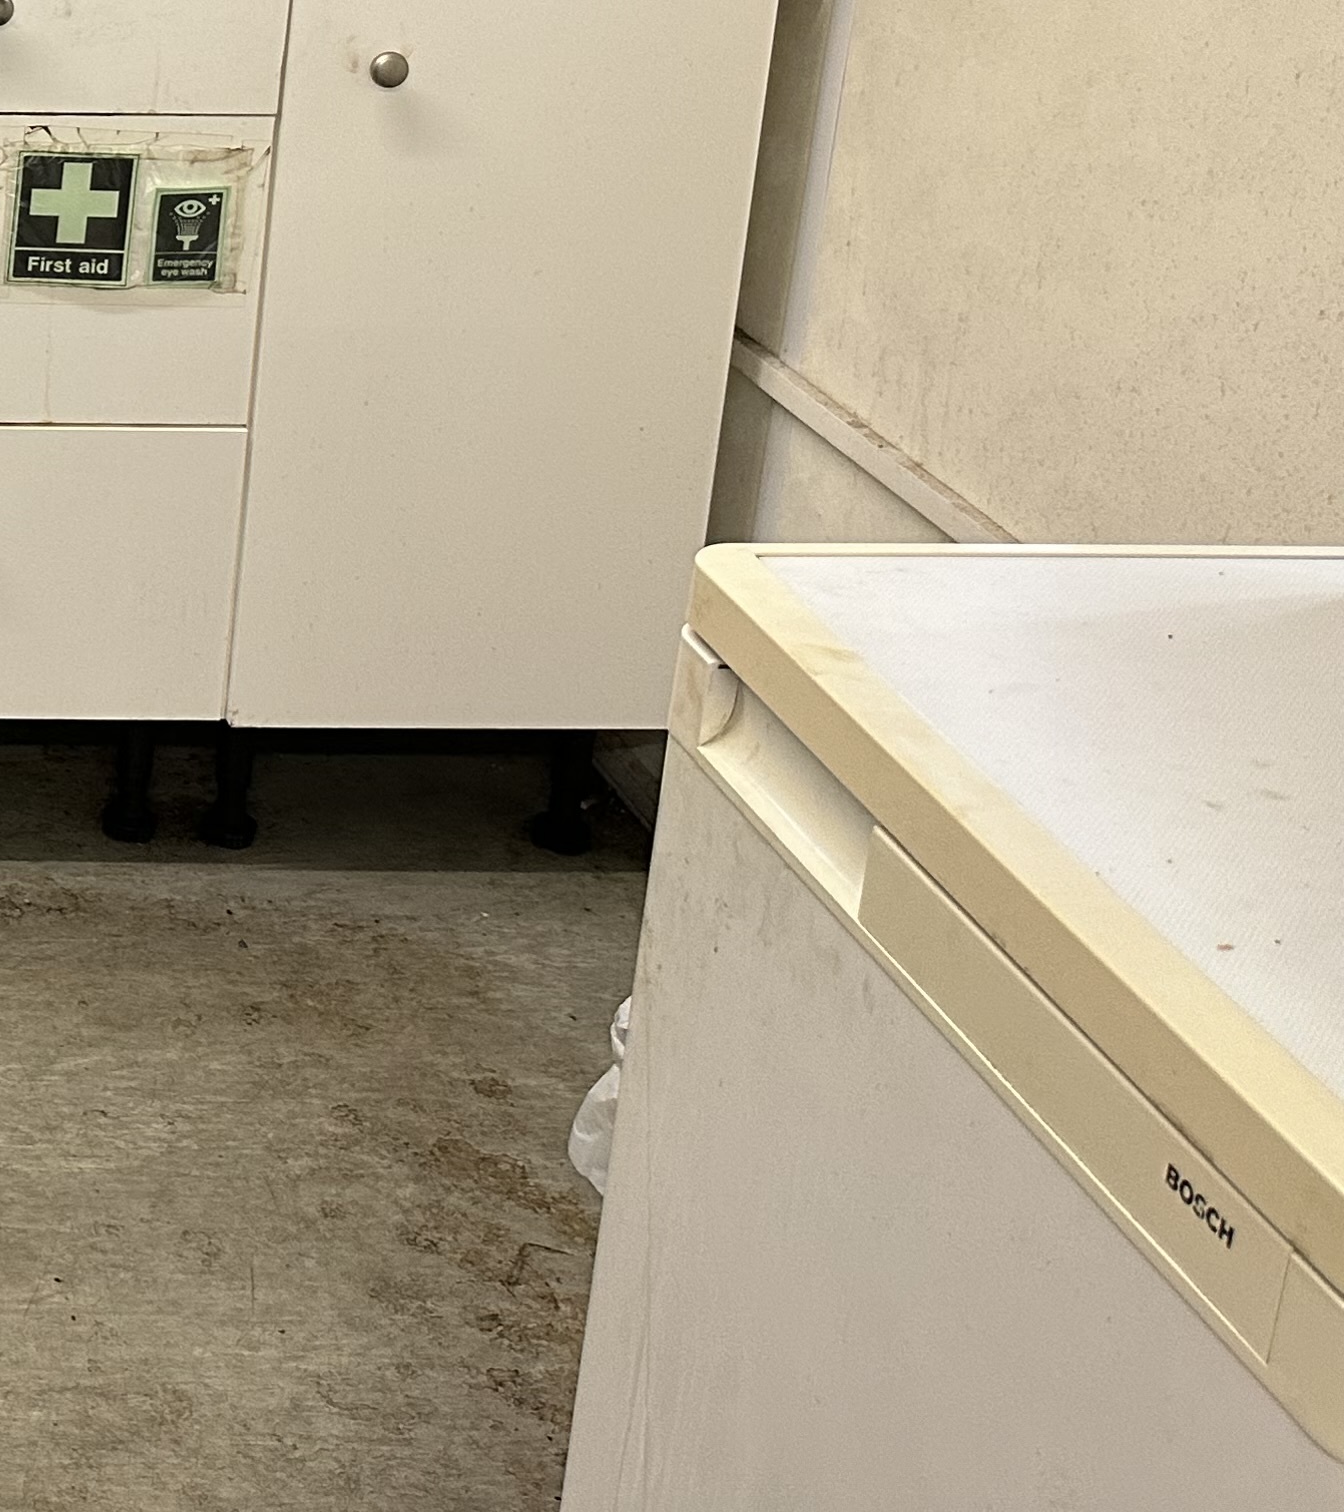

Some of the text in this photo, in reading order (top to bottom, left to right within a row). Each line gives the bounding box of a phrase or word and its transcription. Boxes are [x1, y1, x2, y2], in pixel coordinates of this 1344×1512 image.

[27, 256, 109, 275] First aid
[157, 258, 213, 269] Emergency
[161, 268, 208, 278] eye wash
[1166, 1162, 1235, 1250] BOSCH
